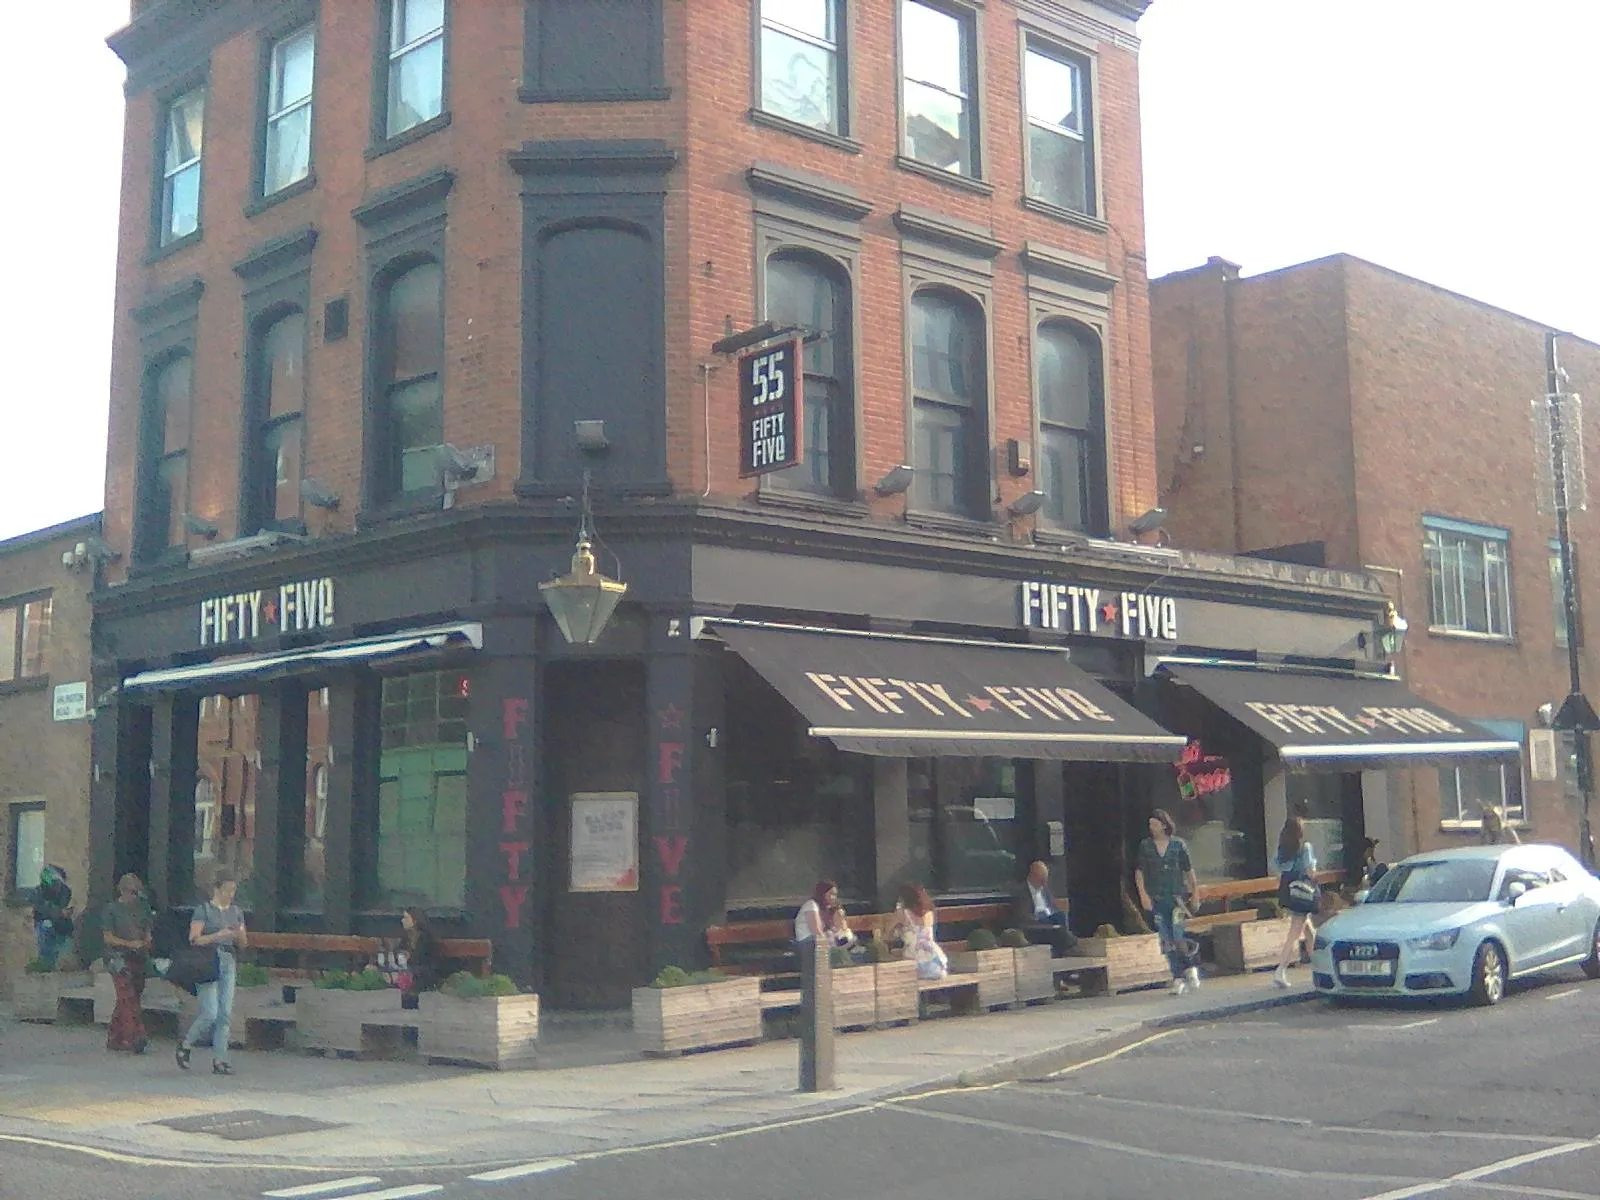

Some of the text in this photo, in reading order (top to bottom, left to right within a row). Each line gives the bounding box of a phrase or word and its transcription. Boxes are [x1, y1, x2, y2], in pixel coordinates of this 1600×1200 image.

[752, 351, 785, 405] 55
[752, 412, 785, 441] FIFTY
[200, 589, 261, 646] FIFTY
[1021, 581, 1100, 632] FIFTY
[804, 671, 975, 719] FIFTY
[1244, 702, 1372, 735] FIFTY
